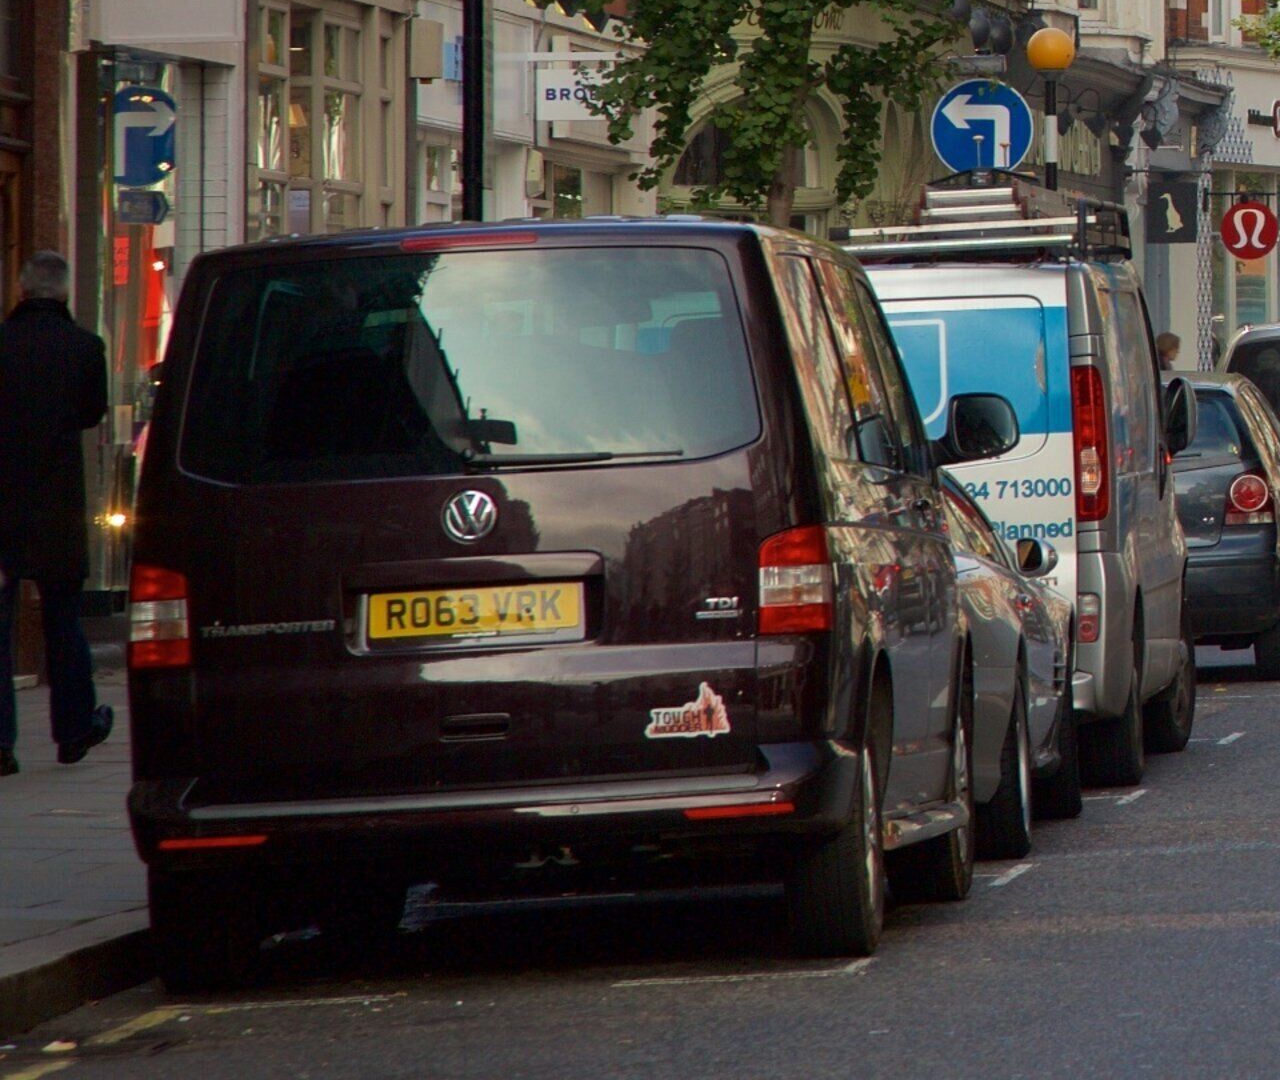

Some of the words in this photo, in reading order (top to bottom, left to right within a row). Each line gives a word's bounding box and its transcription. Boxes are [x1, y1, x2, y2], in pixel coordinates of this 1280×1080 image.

[995, 477, 1072, 499] 713000
[386, 593, 480, 631] RO63
[491, 588, 563, 624] VRK
[705, 595, 740, 610] TDI
[653, 710, 702, 725] TOUCH
